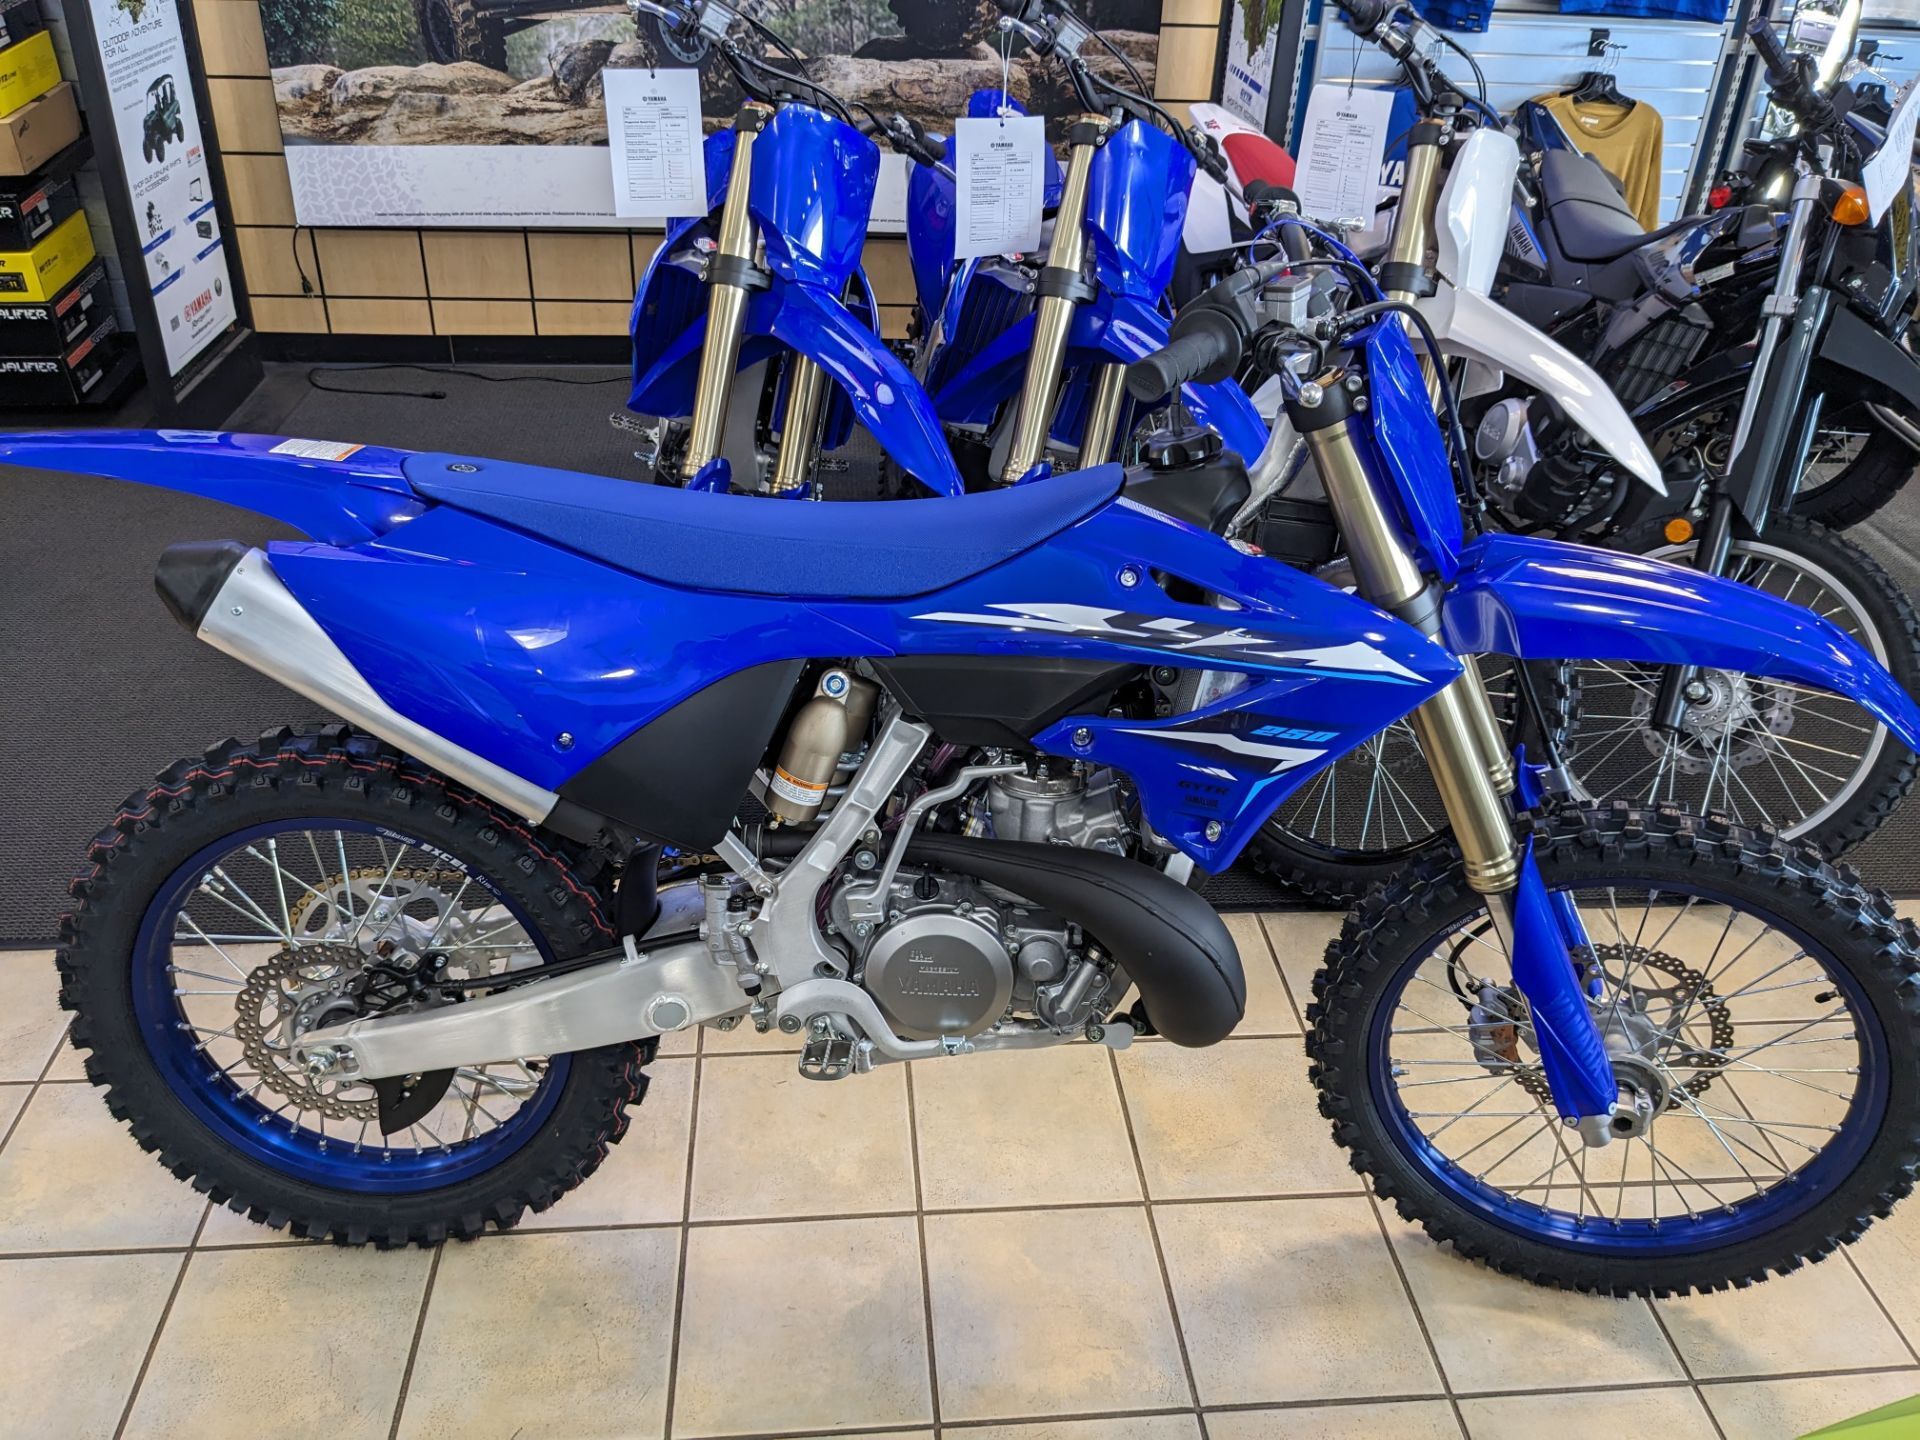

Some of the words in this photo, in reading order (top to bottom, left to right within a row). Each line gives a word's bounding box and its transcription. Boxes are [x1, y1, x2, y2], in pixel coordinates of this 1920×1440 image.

[102, 31, 130, 49] OUTDOOR
[131, 18, 163, 37] ADVENTURE
[104, 47, 116, 58] FOR
[117, 43, 129, 54] ALL
[1511, 222, 1533, 257] YAMAHA
[189, 288, 213, 316] YAMAHA
[1250, 724, 1342, 743] 250
[1178, 780, 1230, 795] GYTR
[420, 843, 468, 873] EXCEL
